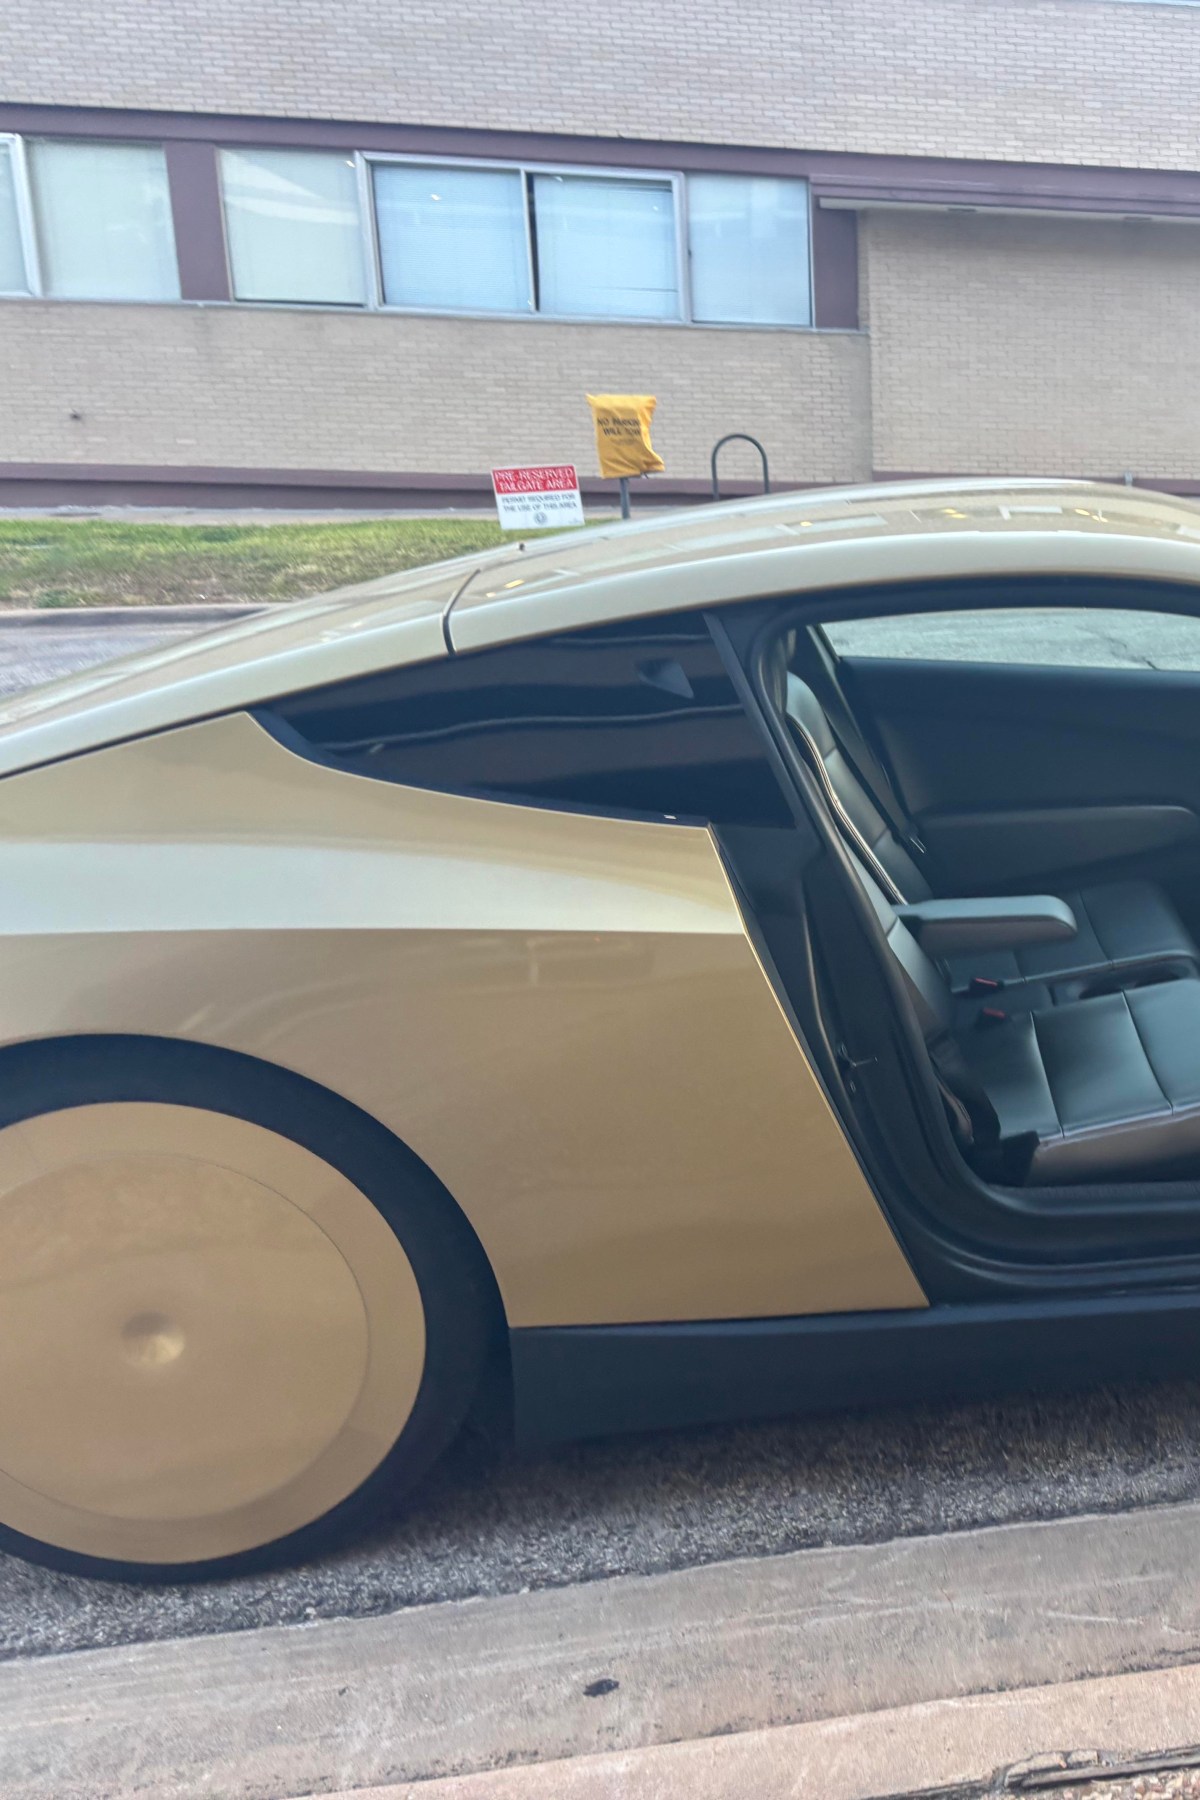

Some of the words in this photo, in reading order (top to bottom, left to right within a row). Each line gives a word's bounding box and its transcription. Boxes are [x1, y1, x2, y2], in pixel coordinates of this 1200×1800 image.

[597, 417, 609, 425] NO
[604, 427, 622, 436] WILL
[495, 468, 574, 481] PRE-RESERVED
[499, 480, 544, 492] TAILGATE
[546, 479, 575, 490] AREA
